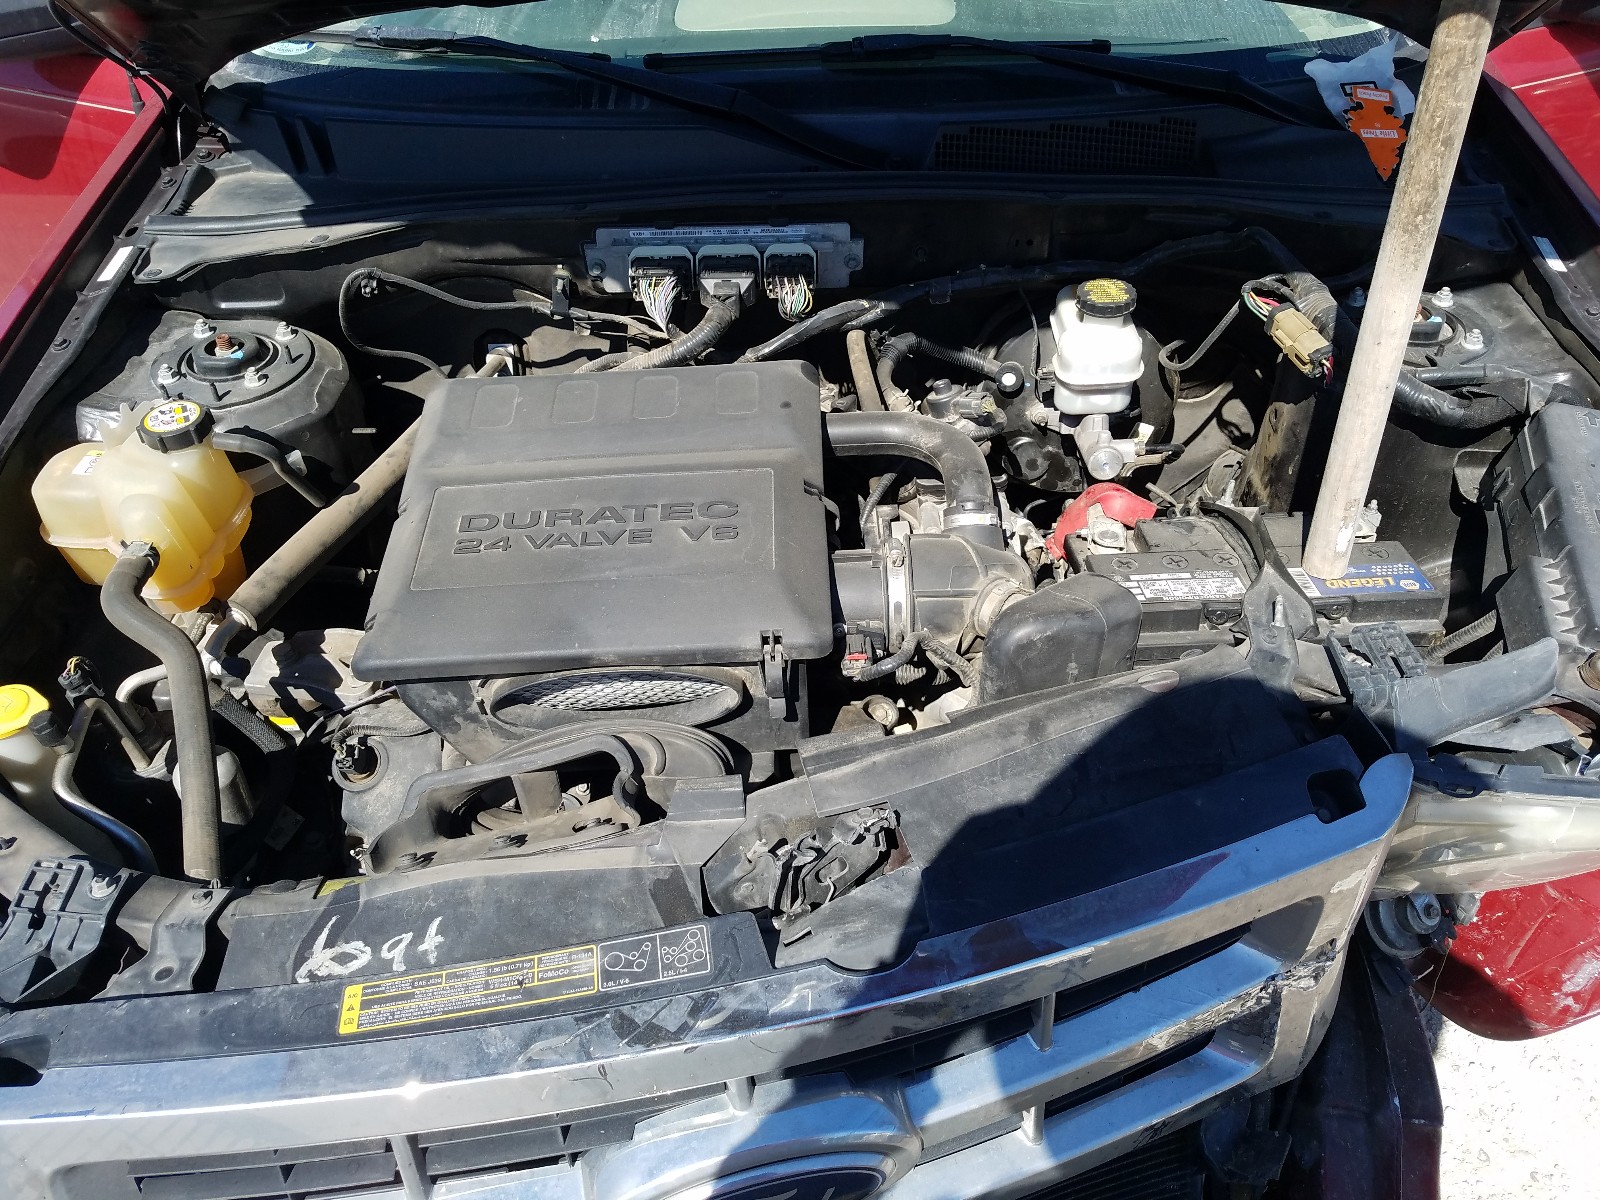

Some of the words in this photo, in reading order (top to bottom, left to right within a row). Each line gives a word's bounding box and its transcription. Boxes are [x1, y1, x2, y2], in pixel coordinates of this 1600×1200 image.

[1380, 129, 1397, 137] Little
[458, 500, 739, 533] DURATEC
[453, 536, 511, 555] 24
[524, 527, 653, 550] VALVE
[680, 524, 739, 542] V6
[1325, 576, 1396, 589] LEGEND
[538, 968, 569, 979] FoMoCo
